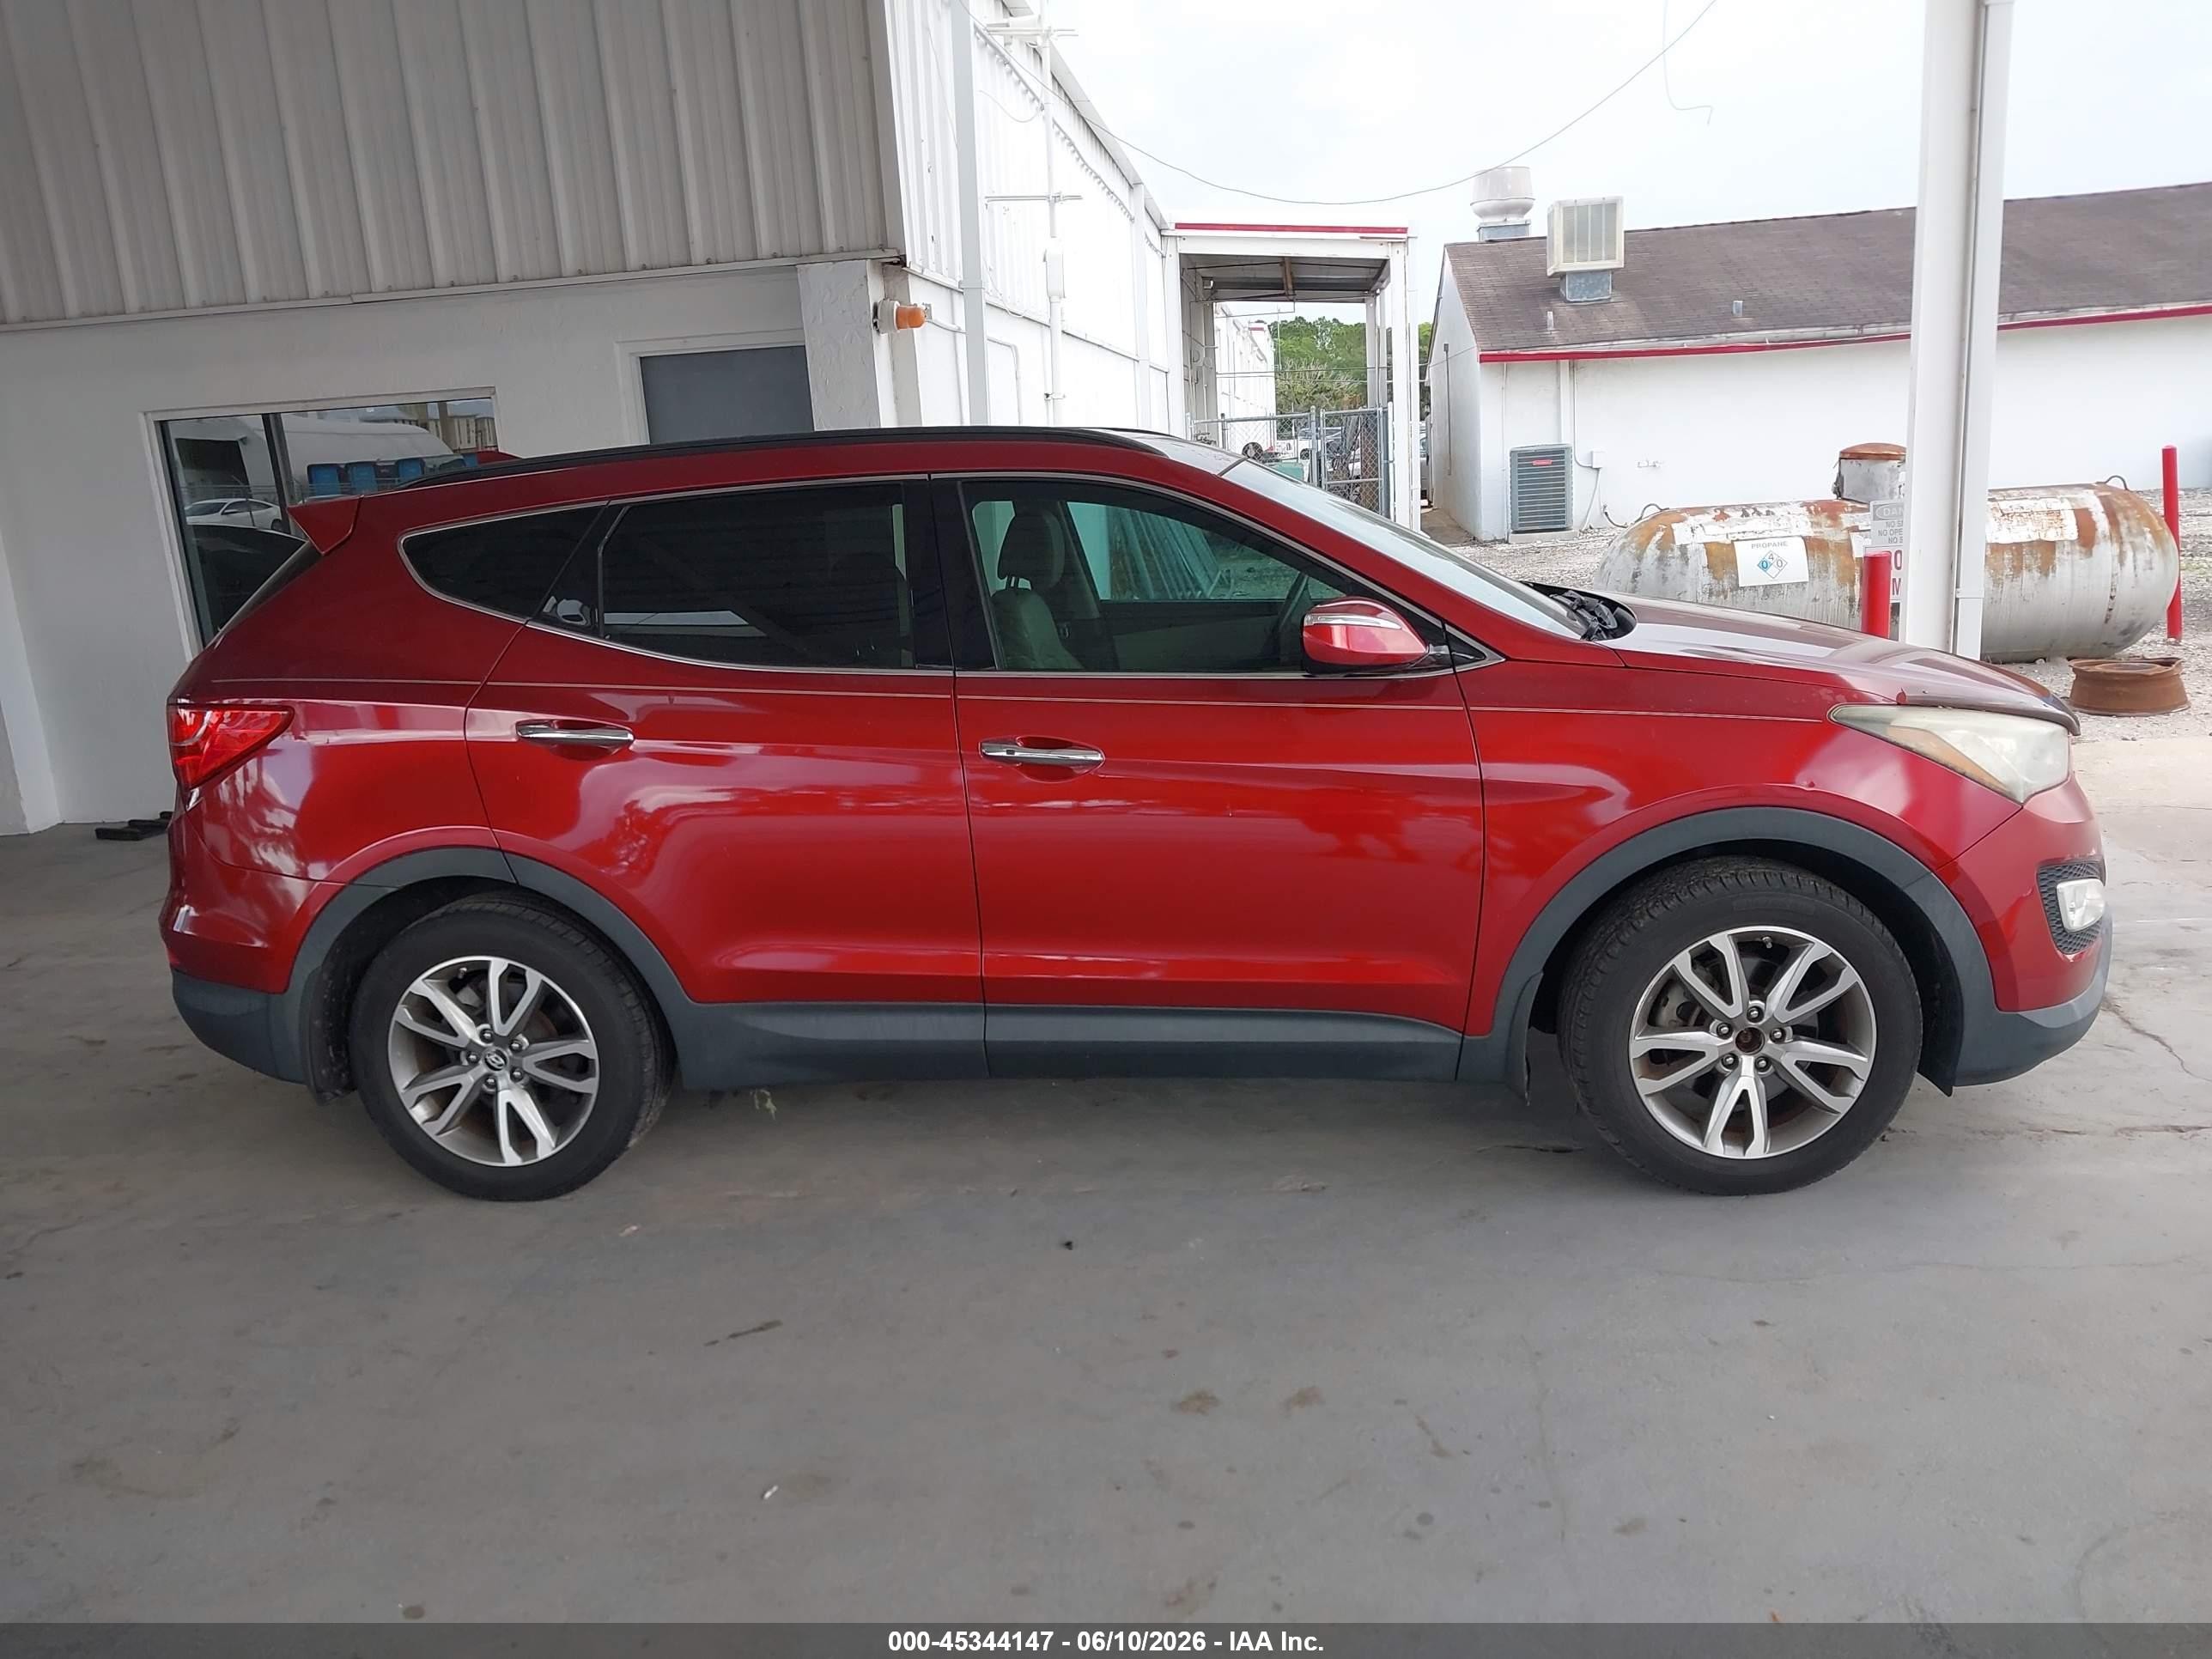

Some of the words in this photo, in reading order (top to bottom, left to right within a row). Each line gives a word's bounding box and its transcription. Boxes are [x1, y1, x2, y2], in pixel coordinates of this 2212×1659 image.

[1883, 507, 1903, 517] DAN
[1889, 528, 1903, 537] OPE
[1751, 541, 1789, 550] PROPANE
[1761, 560, 1769, 569] 0
[1776, 559, 1784, 568] 0
